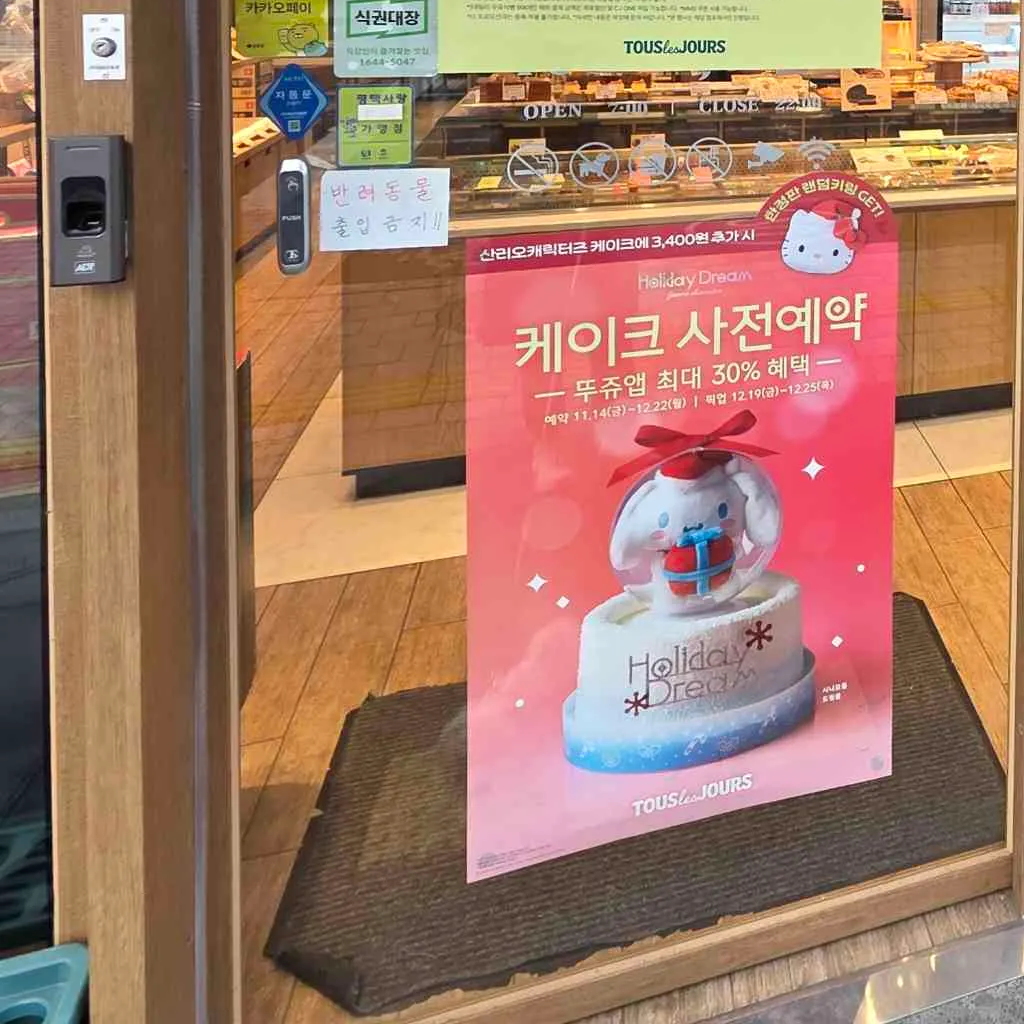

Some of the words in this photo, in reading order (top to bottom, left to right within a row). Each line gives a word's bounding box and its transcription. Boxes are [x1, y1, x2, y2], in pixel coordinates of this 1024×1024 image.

[245, 1, 312, 14] 카카오페이
[355, 10, 420, 26] 식권대장
[522, 103, 583, 120] OPEN
[699, 98, 759, 114] CLOSE
[765, 186, 801, 223] 한정판
[801, 178, 859, 196] 랜덤키링
[858, 190, 885, 218] GET!
[480, 241, 588, 262] 산리오캐릭터즈
[591, 237, 649, 254] 케이크에
[651, 232, 709, 249] 3,400원
[711, 230, 740, 242] 추가
[741, 229, 755, 241] 시
[638, 272, 696, 290] Holiday
[699, 270, 752, 285] Dream
[515, 315, 664, 374] 케이크
[676, 293, 868, 356] 사전예약
[575, 372, 647, 403] 뚜쥬앱
[657, 366, 700, 391] 최대
[712, 361, 761, 385] 30%
[768, 355, 809, 378] 혜택
[545, 412, 569, 426] 예약
[705, 392, 727, 406] 픽업
[628, 640, 753, 695] Holiday
[645, 669, 756, 708] Dream
